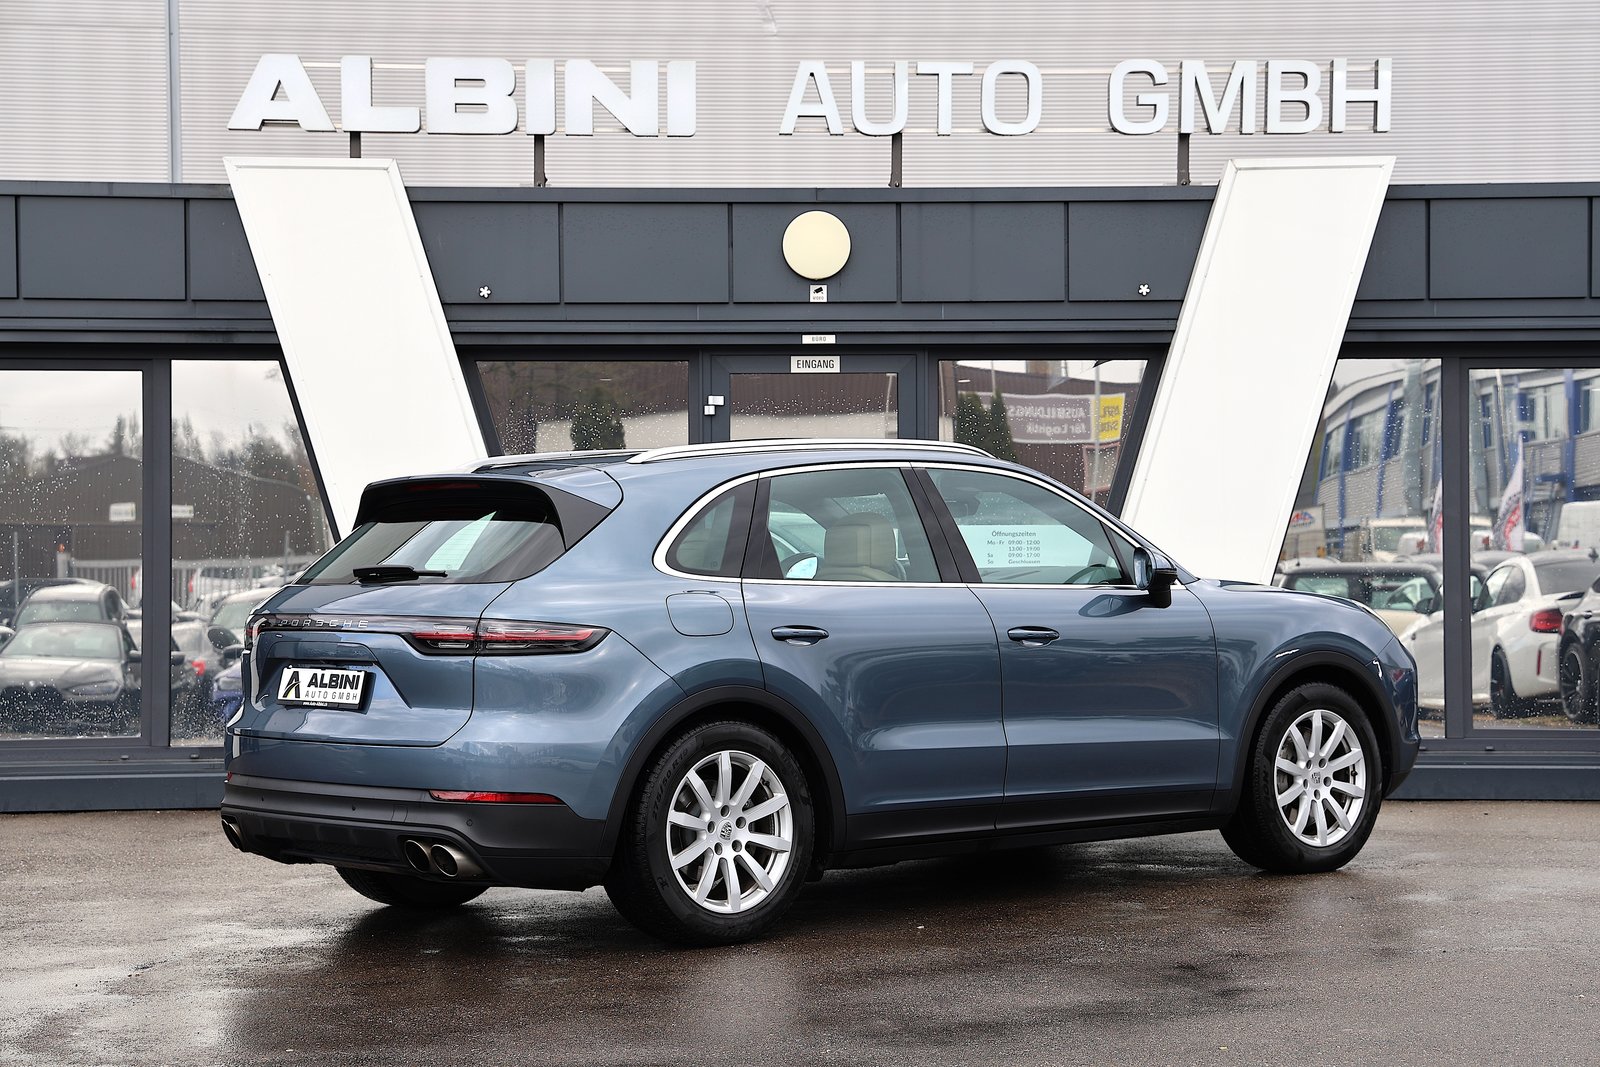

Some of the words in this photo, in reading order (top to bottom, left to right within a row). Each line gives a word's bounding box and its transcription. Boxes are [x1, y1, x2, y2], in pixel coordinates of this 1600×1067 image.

[227, 53, 696, 137] ALBINI
[779, 59, 1043, 137] AUTO
[1107, 57, 1393, 136] GMBH
[796, 359, 835, 369] EINGANG
[279, 619, 369, 628] PORSCHE
[307, 672, 361, 690] ALBINI
[304, 690, 328, 700] AUTO
[331, 691, 358, 701] GMBH
